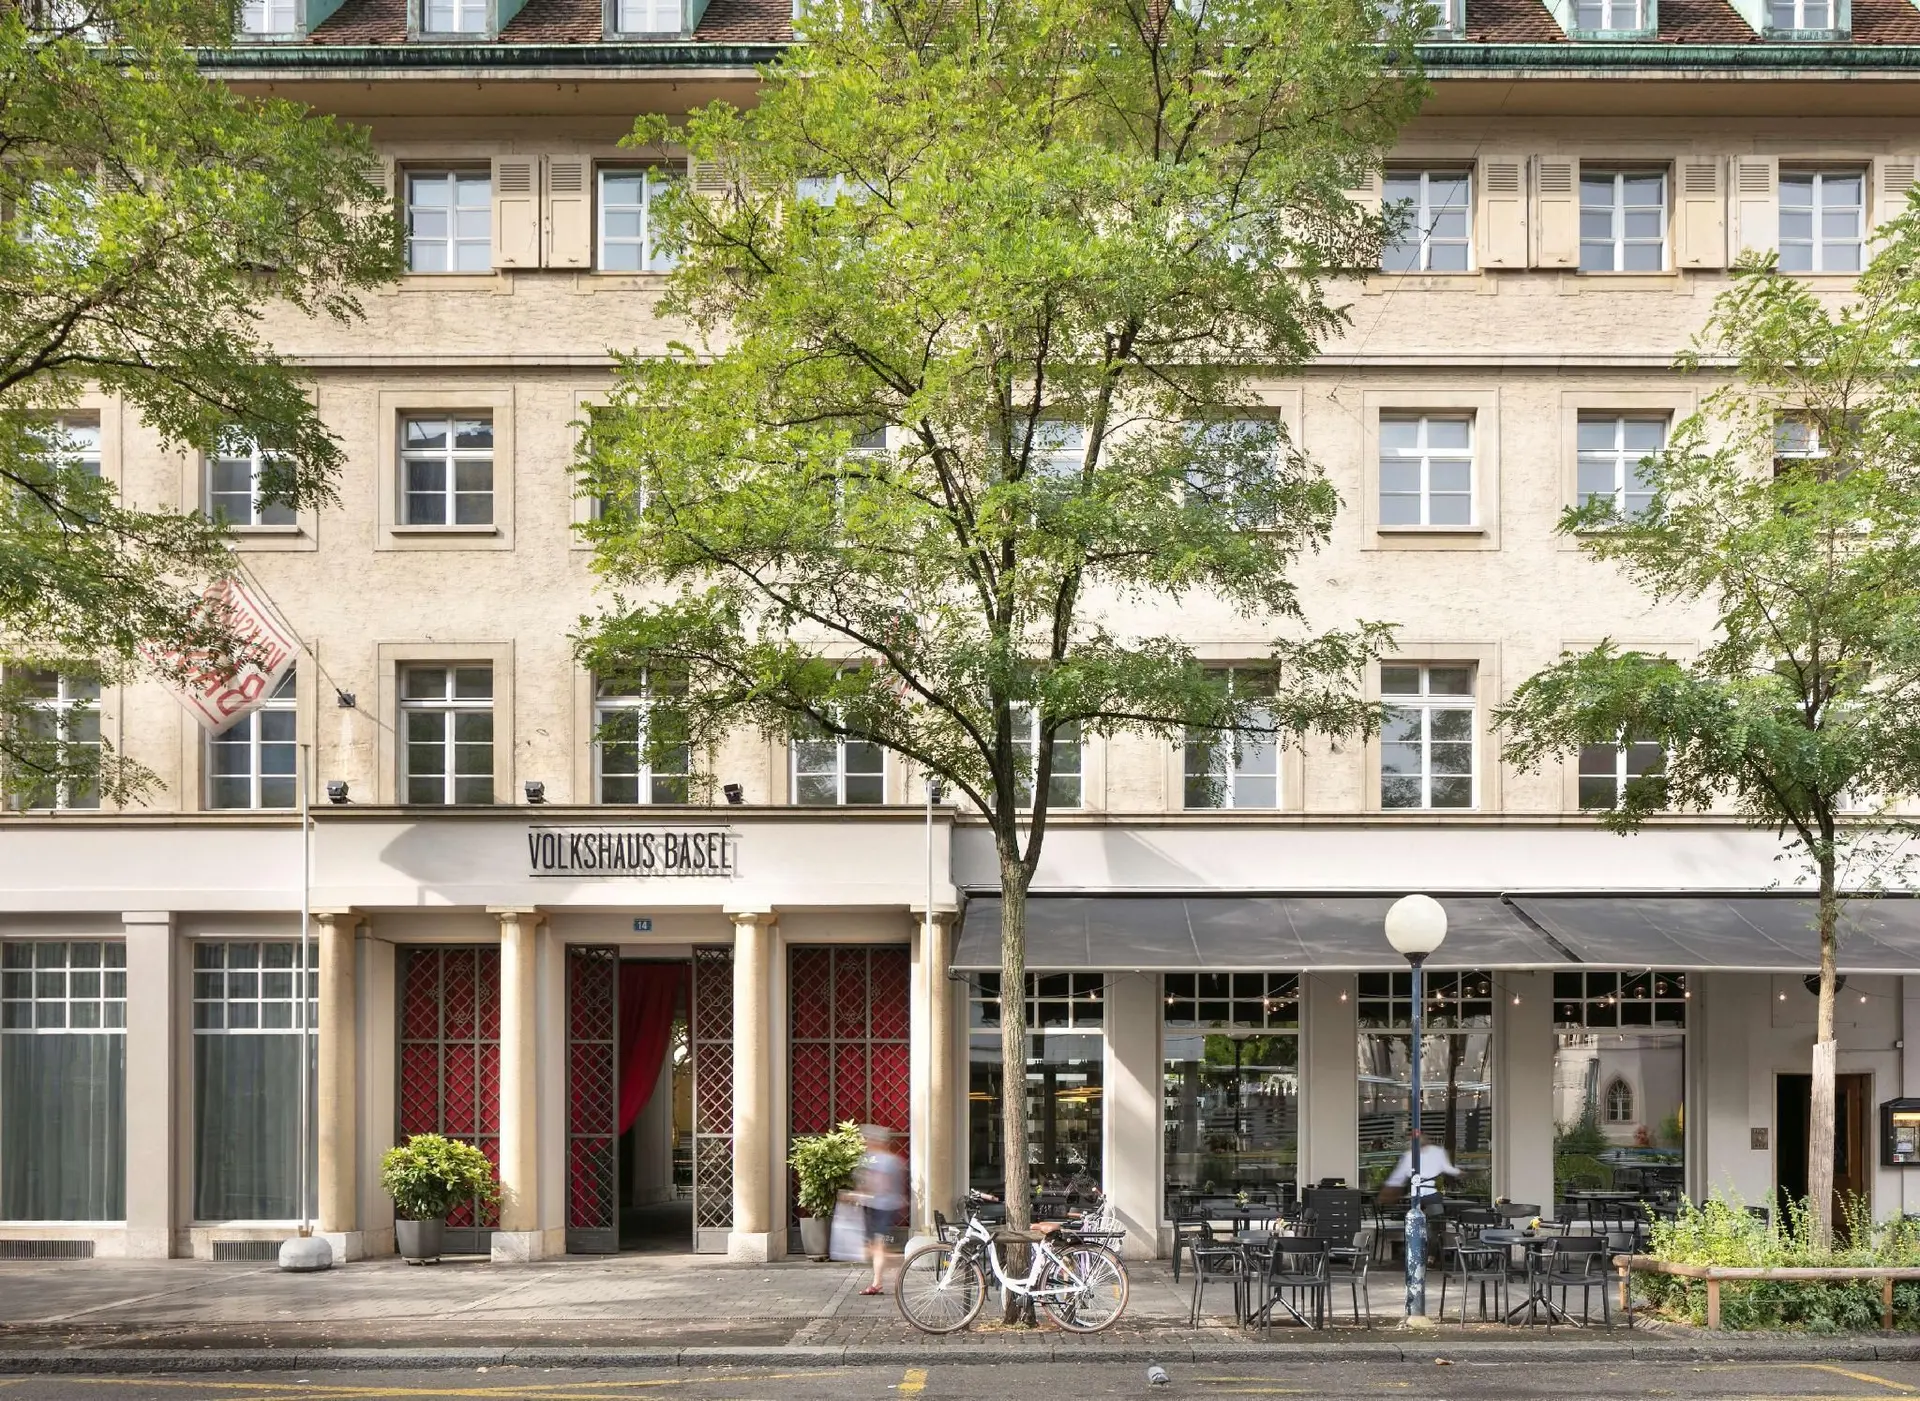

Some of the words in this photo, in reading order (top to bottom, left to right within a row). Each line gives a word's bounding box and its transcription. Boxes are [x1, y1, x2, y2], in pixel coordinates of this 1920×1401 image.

[528, 833, 655, 869] VOLKSHAUS
[664, 832, 732, 869] BASEL
[638, 921, 648, 930] 14
